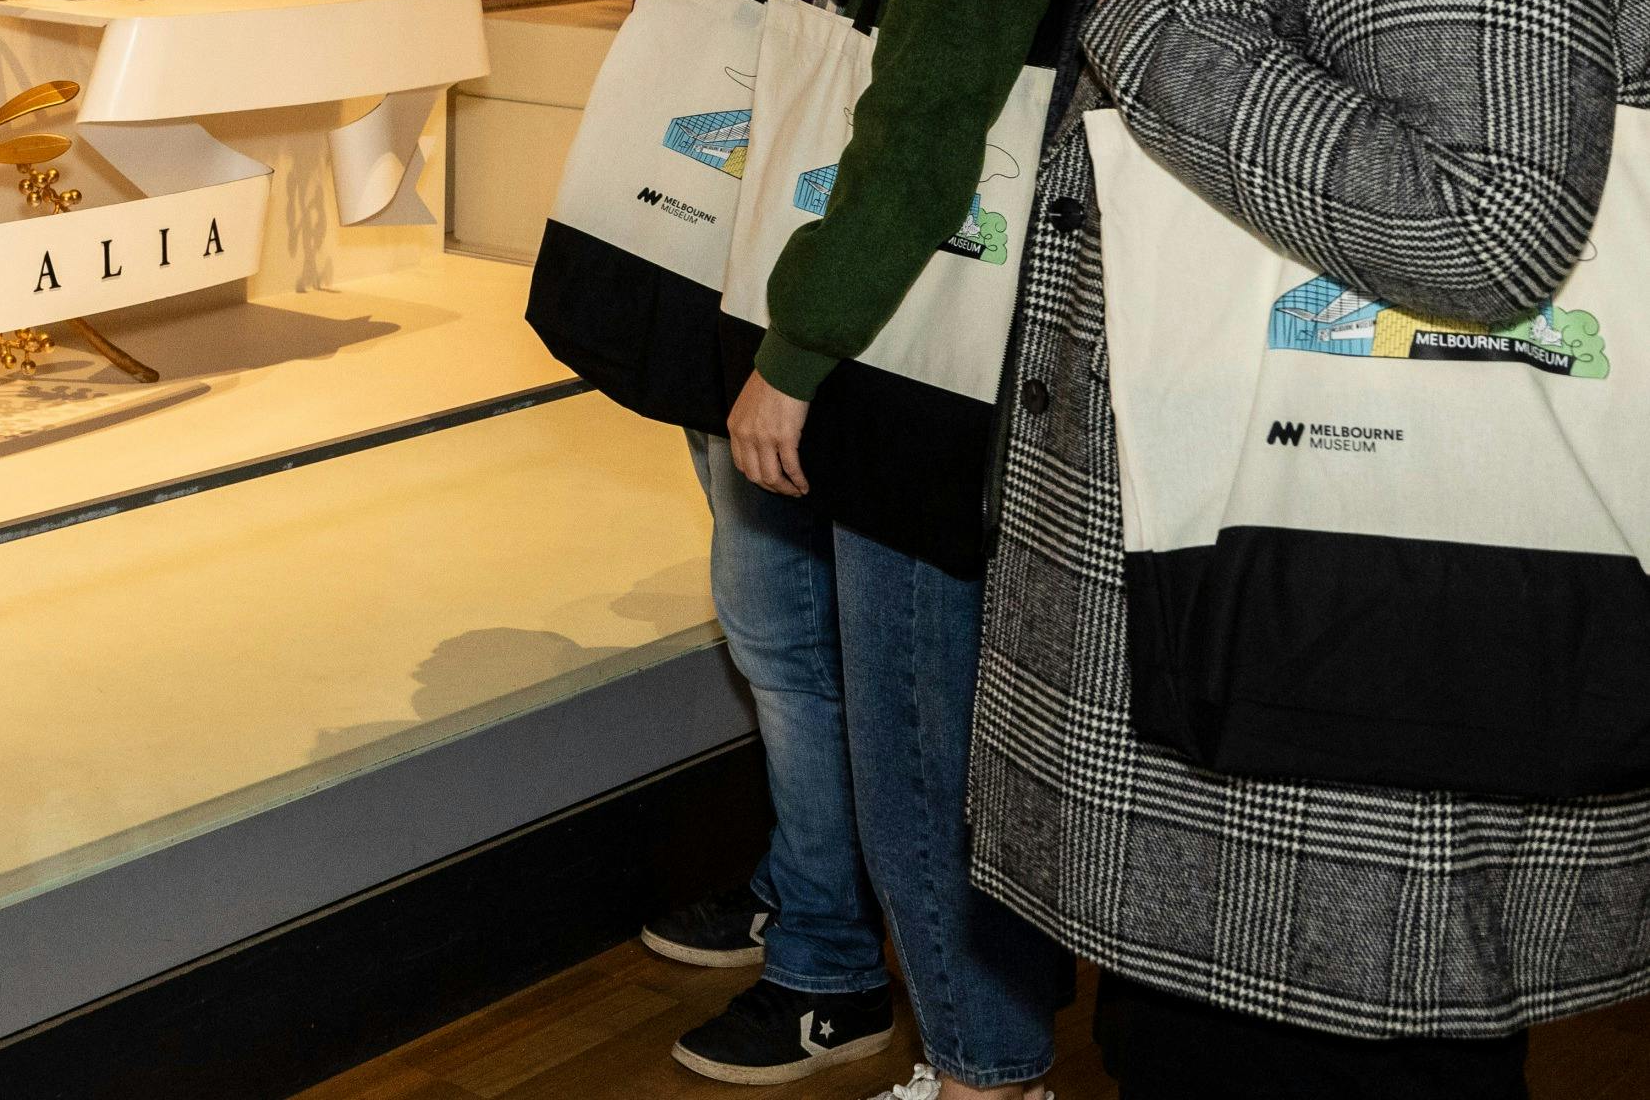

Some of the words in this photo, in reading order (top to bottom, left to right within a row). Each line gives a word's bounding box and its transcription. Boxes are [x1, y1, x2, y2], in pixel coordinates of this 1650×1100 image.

[660, 203, 698, 225] MUSEUM
[664, 196, 717, 224] MELBOURNE
[1415, 332, 1510, 351] MELBOURNE
[1514, 340, 1569, 368] MUSEUM
[1310, 423, 1404, 441] MELBOURNE
[1310, 437, 1377, 453] MUSEUM
